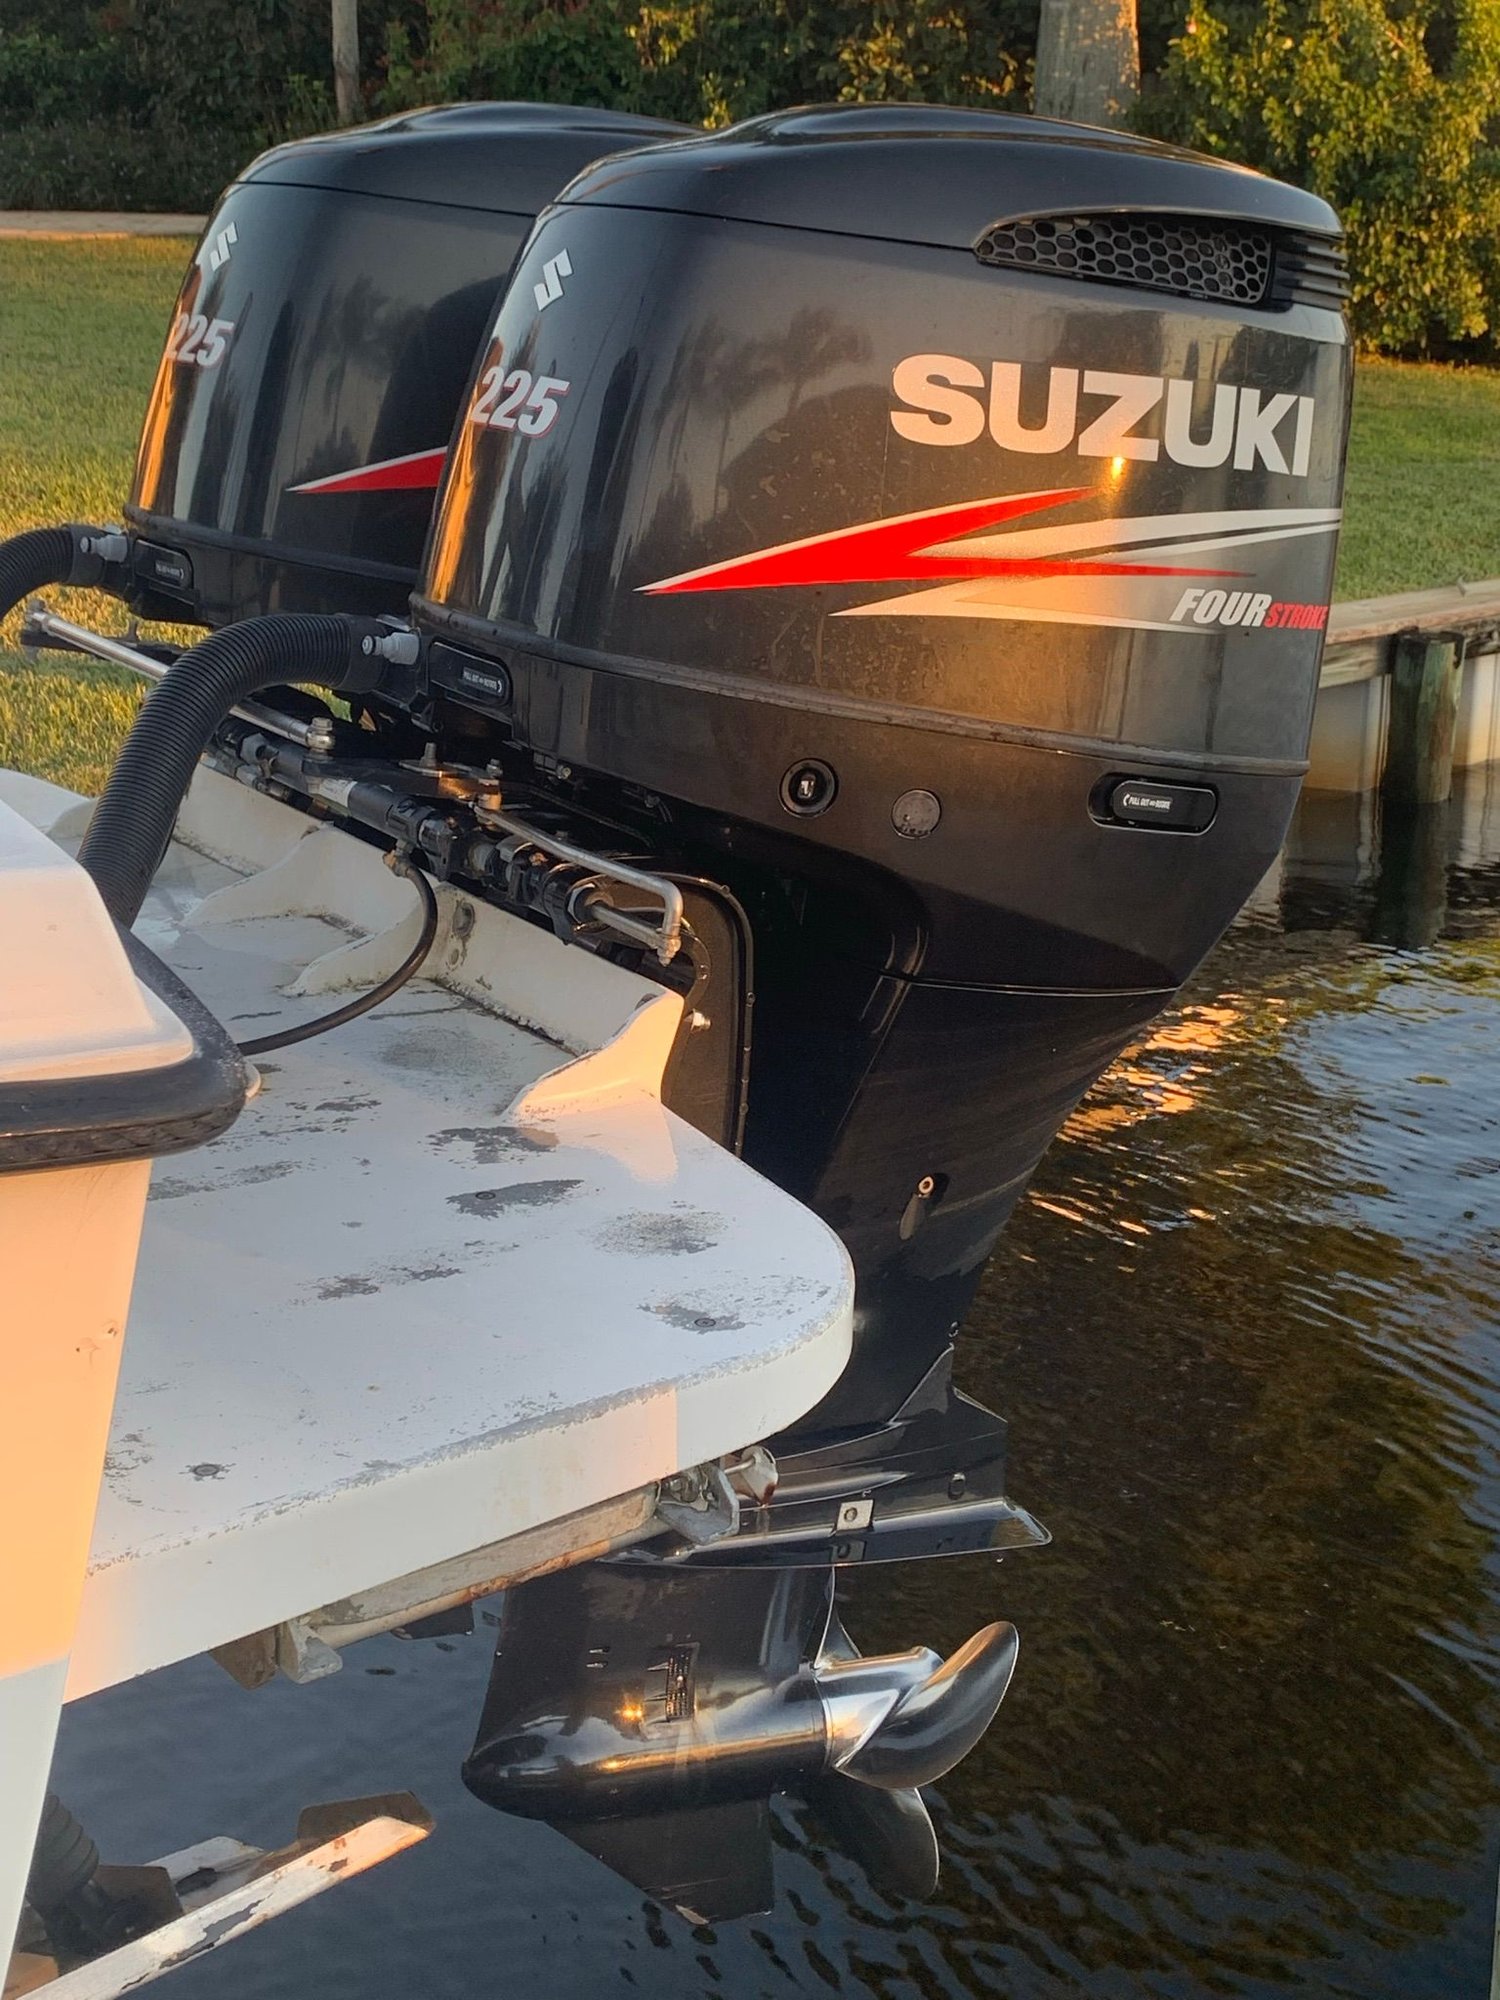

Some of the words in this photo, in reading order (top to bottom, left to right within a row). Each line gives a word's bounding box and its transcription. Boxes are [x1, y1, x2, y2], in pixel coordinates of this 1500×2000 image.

[163, 312, 235, 367] 225
[470, 366, 570, 438] 225
[890, 354, 1315, 477] SUZUKI
[1169, 588, 1272, 628] FOUR
[1263, 602, 1329, 630] STROKE
